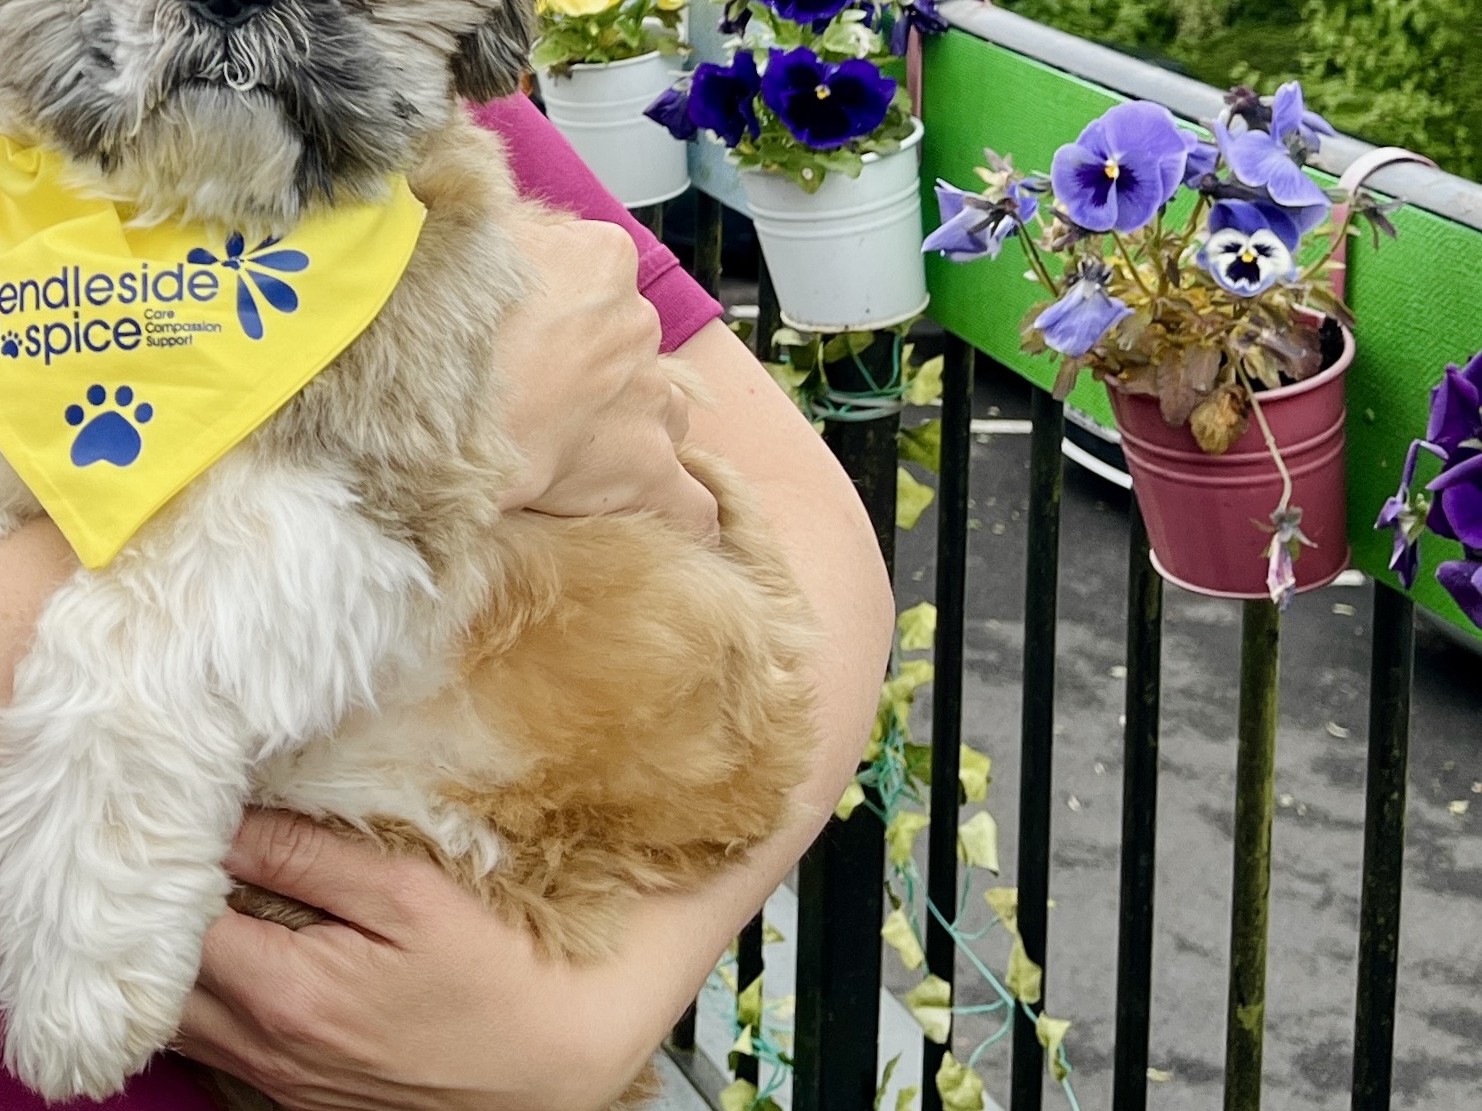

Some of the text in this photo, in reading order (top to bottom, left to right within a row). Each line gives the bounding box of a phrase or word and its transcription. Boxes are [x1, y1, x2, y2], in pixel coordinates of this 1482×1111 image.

[144, 308, 176, 320] Care
[145, 320, 223, 334] Compassion
[146, 334, 193, 347] Support
